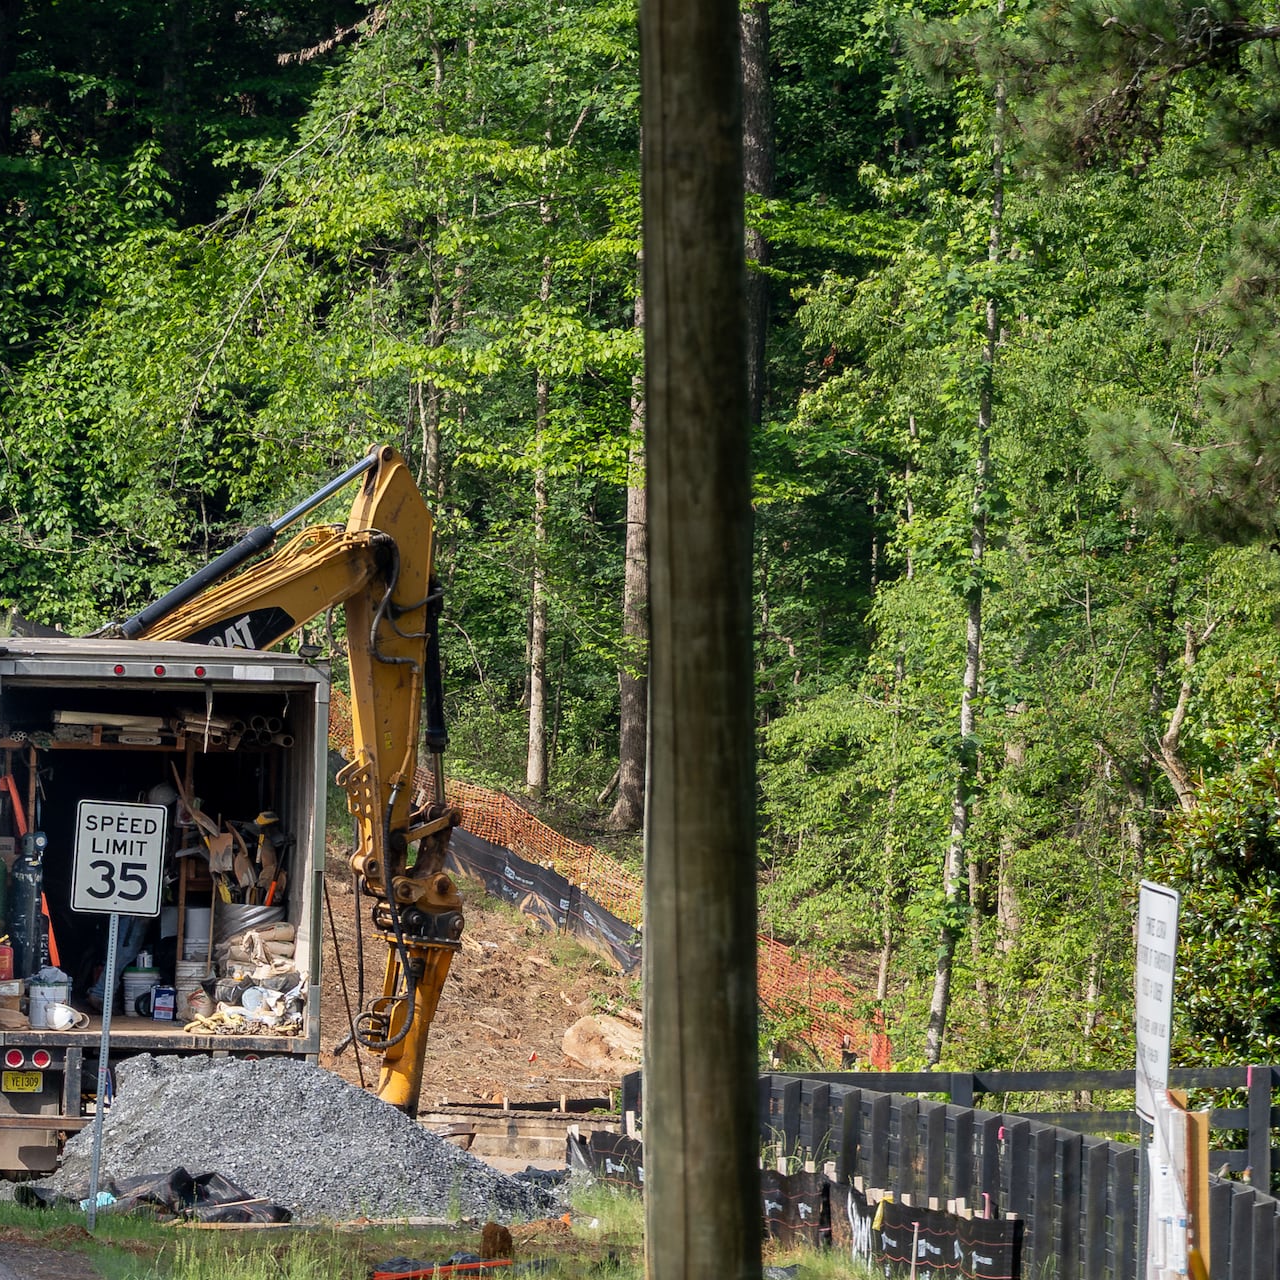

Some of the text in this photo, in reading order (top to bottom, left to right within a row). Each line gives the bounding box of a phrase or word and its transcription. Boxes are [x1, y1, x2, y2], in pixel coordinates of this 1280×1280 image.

[85, 814, 157, 835] SPEED
[91, 837, 148, 857] LIMIT
[85, 859, 148, 901] 35
